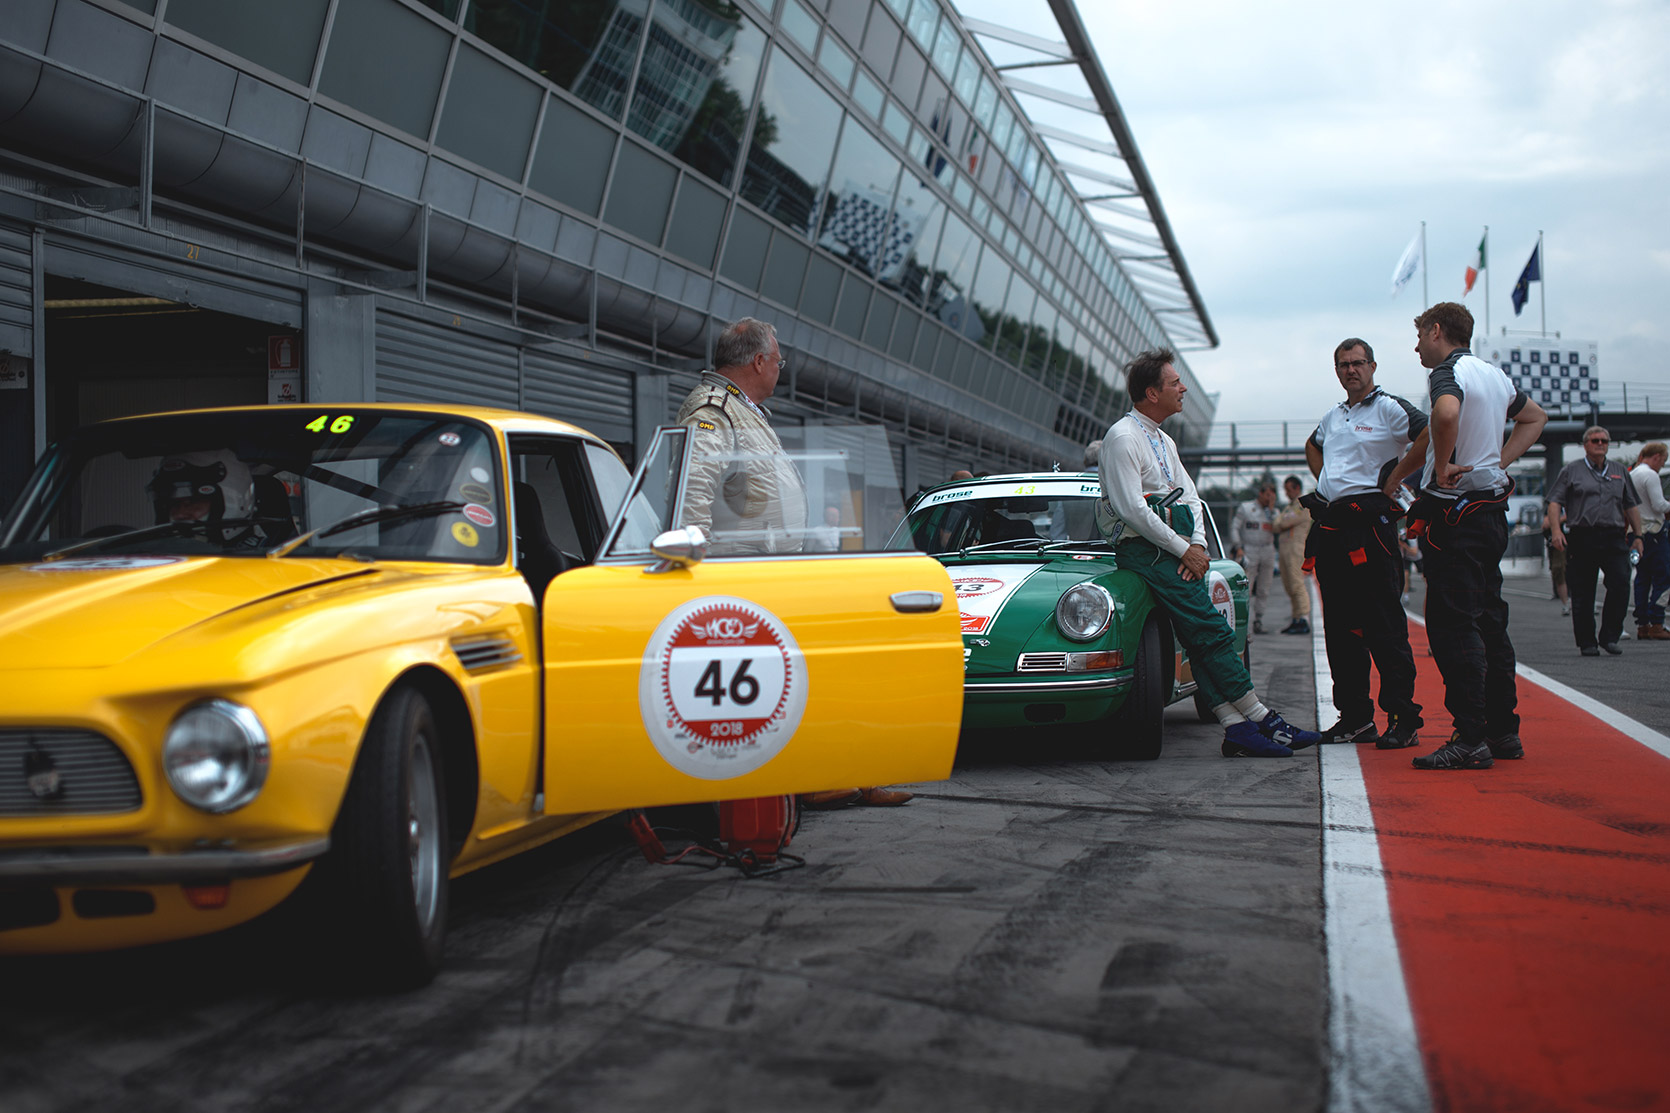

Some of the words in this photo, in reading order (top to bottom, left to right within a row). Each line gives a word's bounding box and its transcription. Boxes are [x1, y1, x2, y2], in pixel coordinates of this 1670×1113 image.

[187, 243, 200, 260] 27
[727, 385, 740, 395] OMP
[305, 415, 354, 433] 46
[699, 422, 714, 430] OMP
[932, 490, 973, 502] brose
[1014, 485, 1036, 495] 43
[694, 659, 760, 706] 46
[710, 721, 744, 737] 2018
